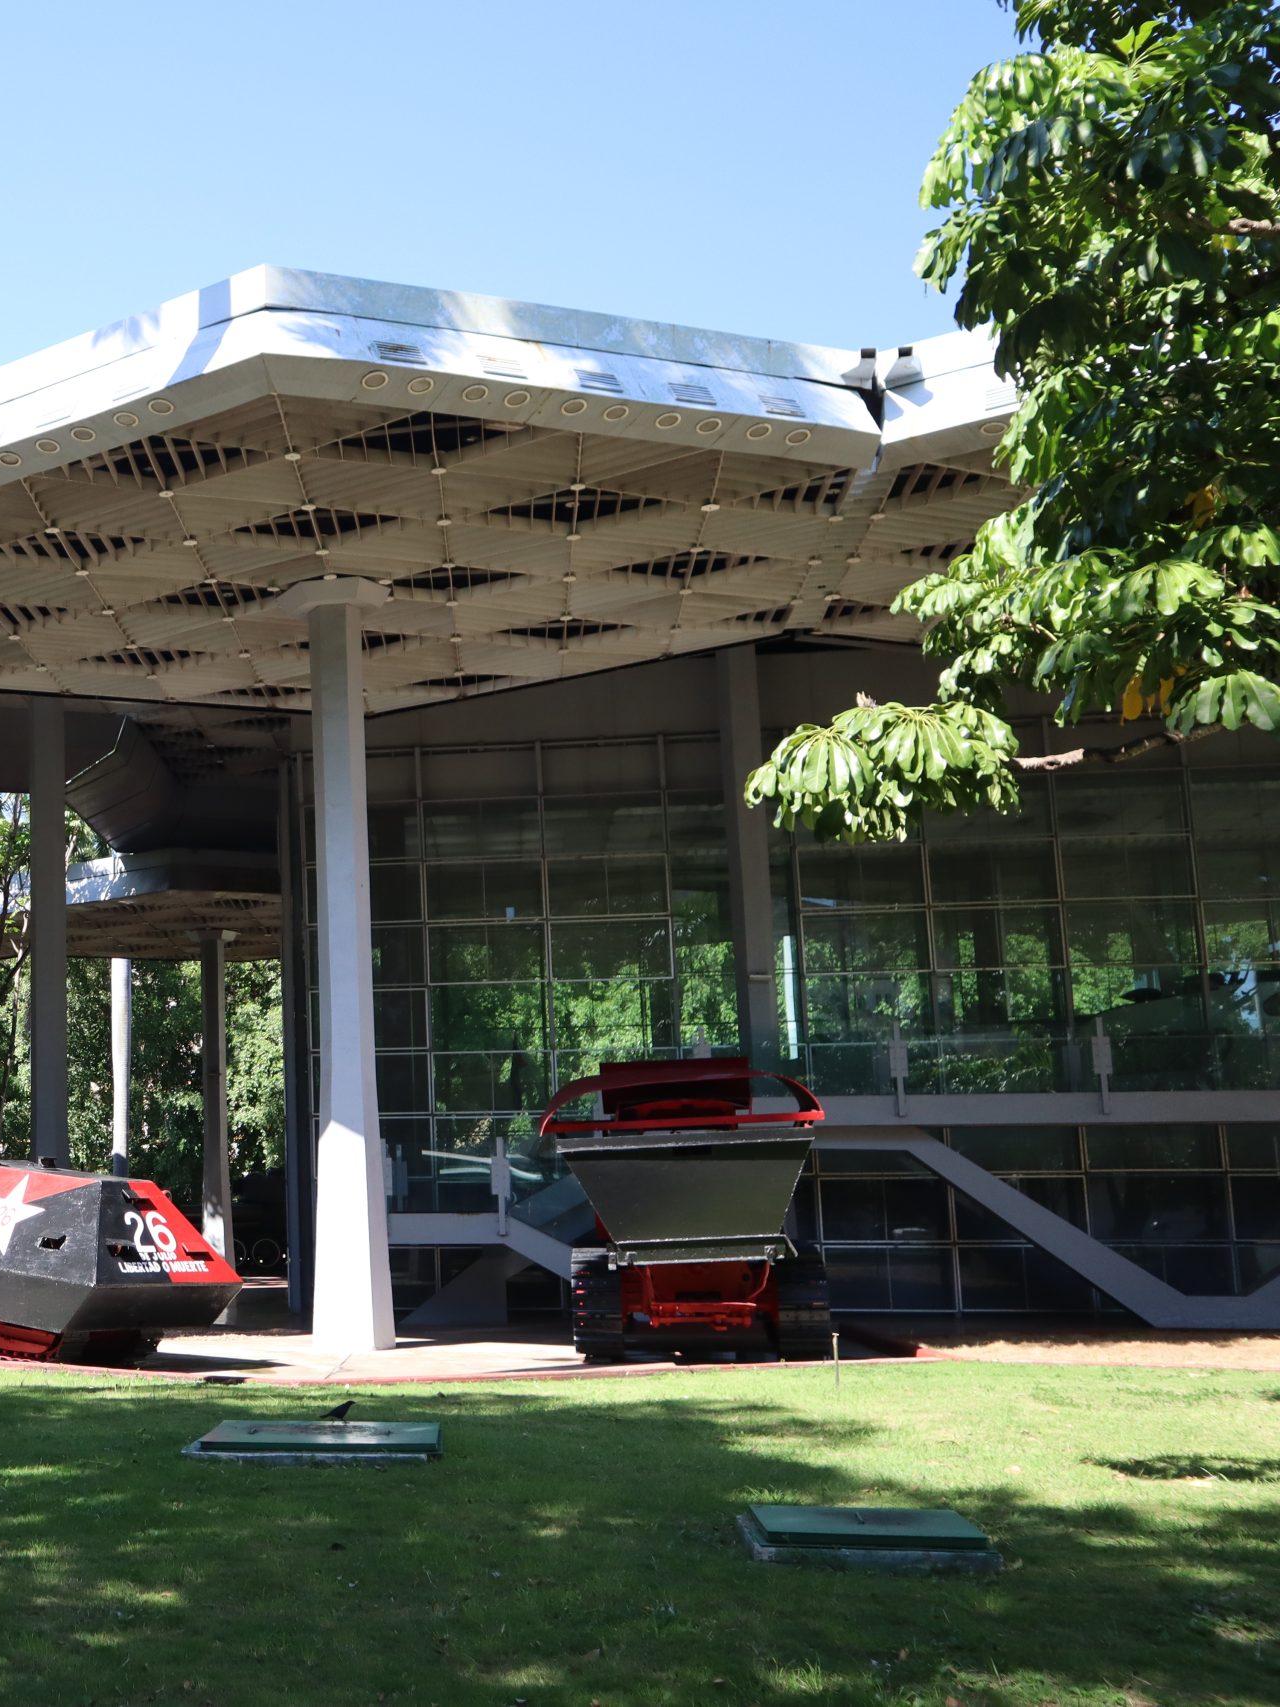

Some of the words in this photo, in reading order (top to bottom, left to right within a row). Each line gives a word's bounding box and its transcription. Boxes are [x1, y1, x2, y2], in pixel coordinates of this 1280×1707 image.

[123, 1210, 177, 1253] 26
[152, 1251, 177, 1261] JULIO
[118, 1261, 161, 1273] LIBERTAD
[161, 1261, 171, 1273] O
[170, 1260, 209, 1273] MUERTE
